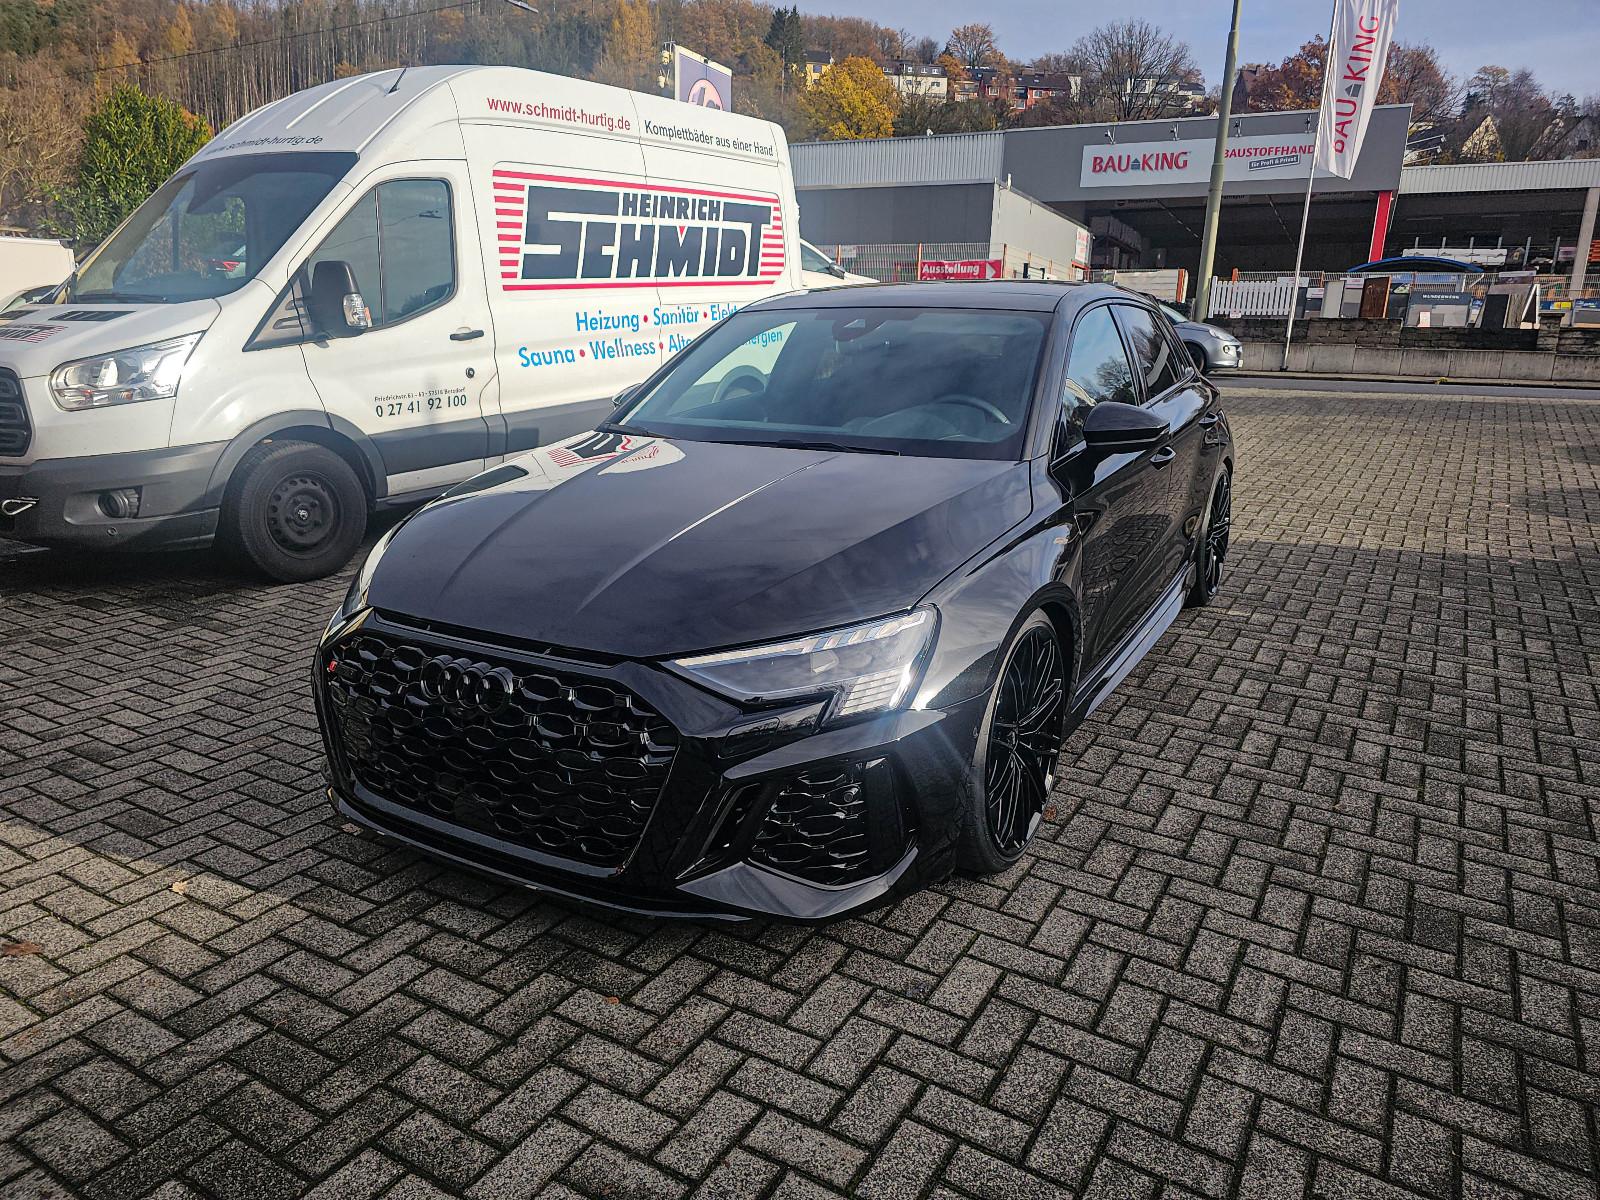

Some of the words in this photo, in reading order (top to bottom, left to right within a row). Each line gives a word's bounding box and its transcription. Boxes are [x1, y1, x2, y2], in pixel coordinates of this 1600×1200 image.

[1343, 15, 1380, 82] KING
[486, 97, 631, 132] www.schmidt-hurtig.de
[644, 119, 714, 145] Komplettbäder
[715, 136, 731, 148] aus
[733, 138, 752, 153] einer
[753, 141, 774, 156] Hand
[1092, 154, 1131, 173] BAU
[1141, 151, 1189, 171] KING
[1251, 160, 1259, 168] für
[1260, 158, 1274, 167] Profi
[1279, 156, 1297, 164] Privat
[622, 192, 721, 221] HEINRICH
[521, 185, 772, 280] SCHMIDT
[922, 263, 980, 276] Ausstellung
[575, 310, 640, 333] Heizung
[653, 305, 699, 326] Sanitär
[518, 346, 575, 368] Sauna
[589, 338, 656, 361] Wellness
[375, 405, 383, 418] 0
[387, 402, 402, 417] 27
[407, 401, 420, 414] 41
[427, 397, 442, 411] 92
[447, 394, 467, 408] 100
